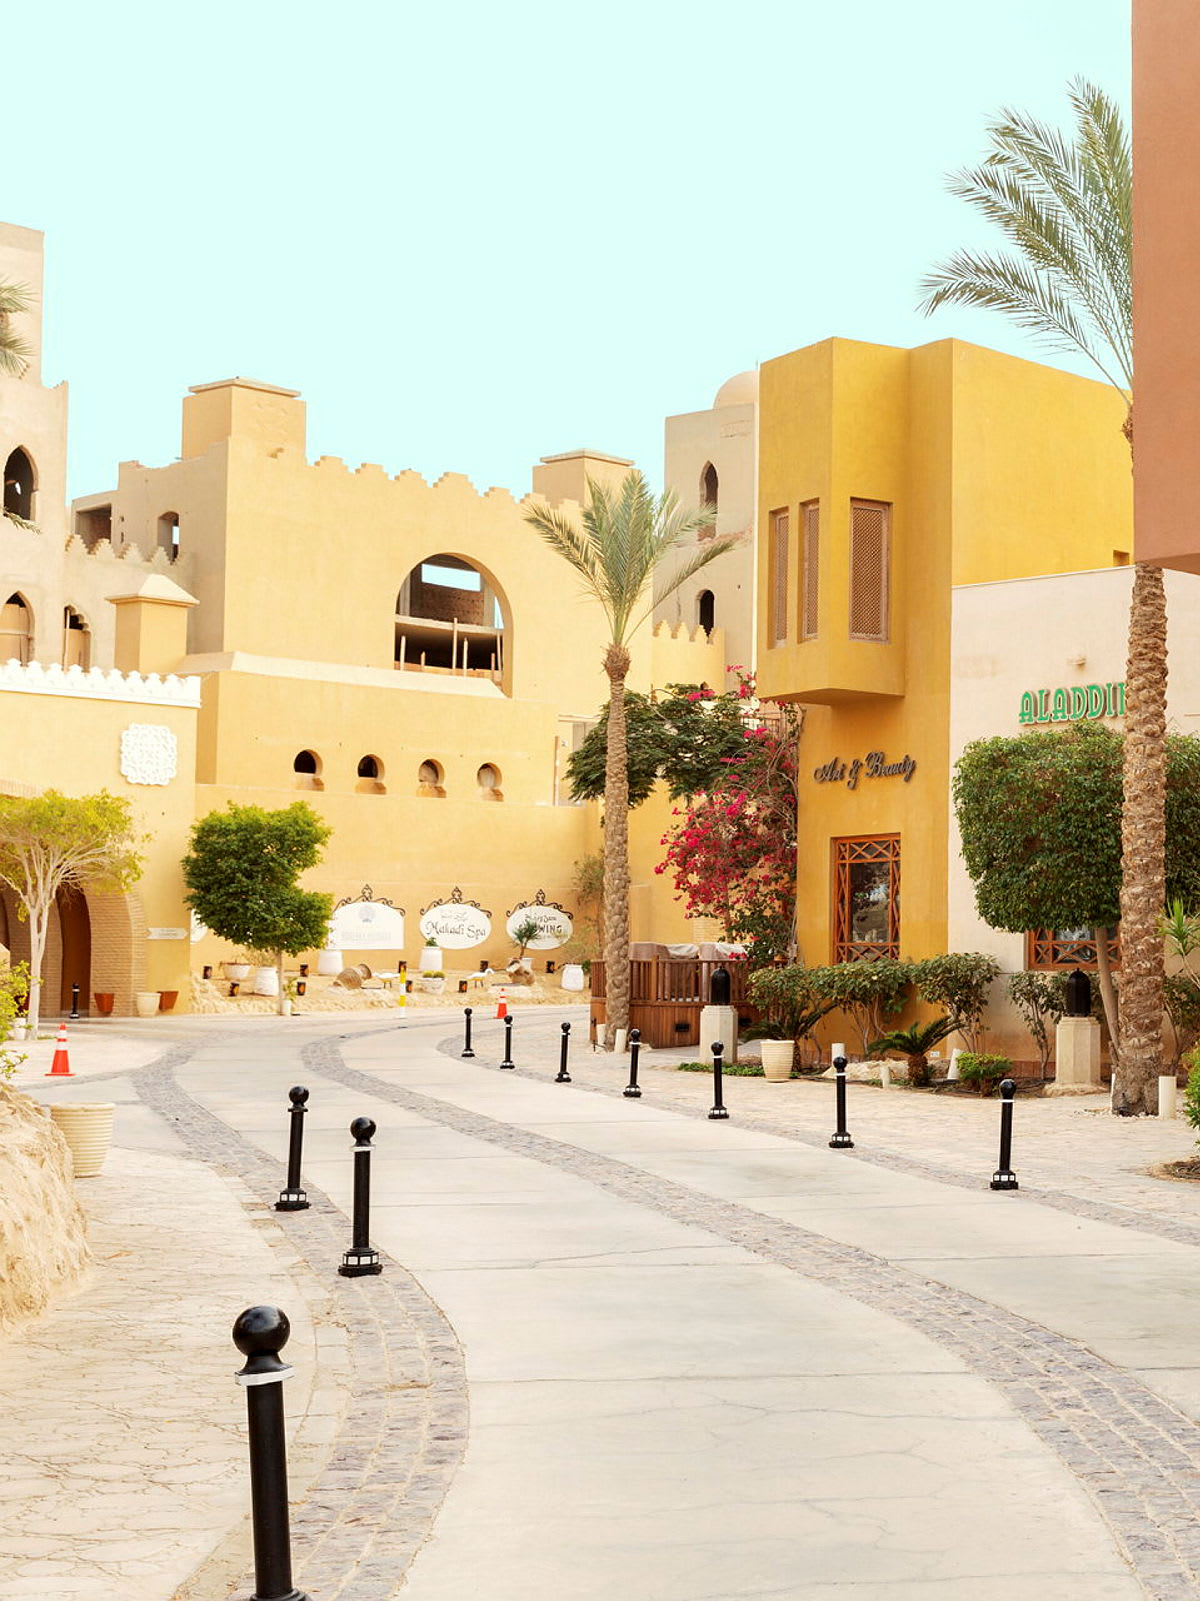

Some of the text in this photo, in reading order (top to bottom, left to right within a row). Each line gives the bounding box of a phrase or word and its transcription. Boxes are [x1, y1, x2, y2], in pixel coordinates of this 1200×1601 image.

[814, 757, 847, 784] Art
[864, 751, 917, 782] Beauty
[425, 921, 487, 940] Makadi Spa
